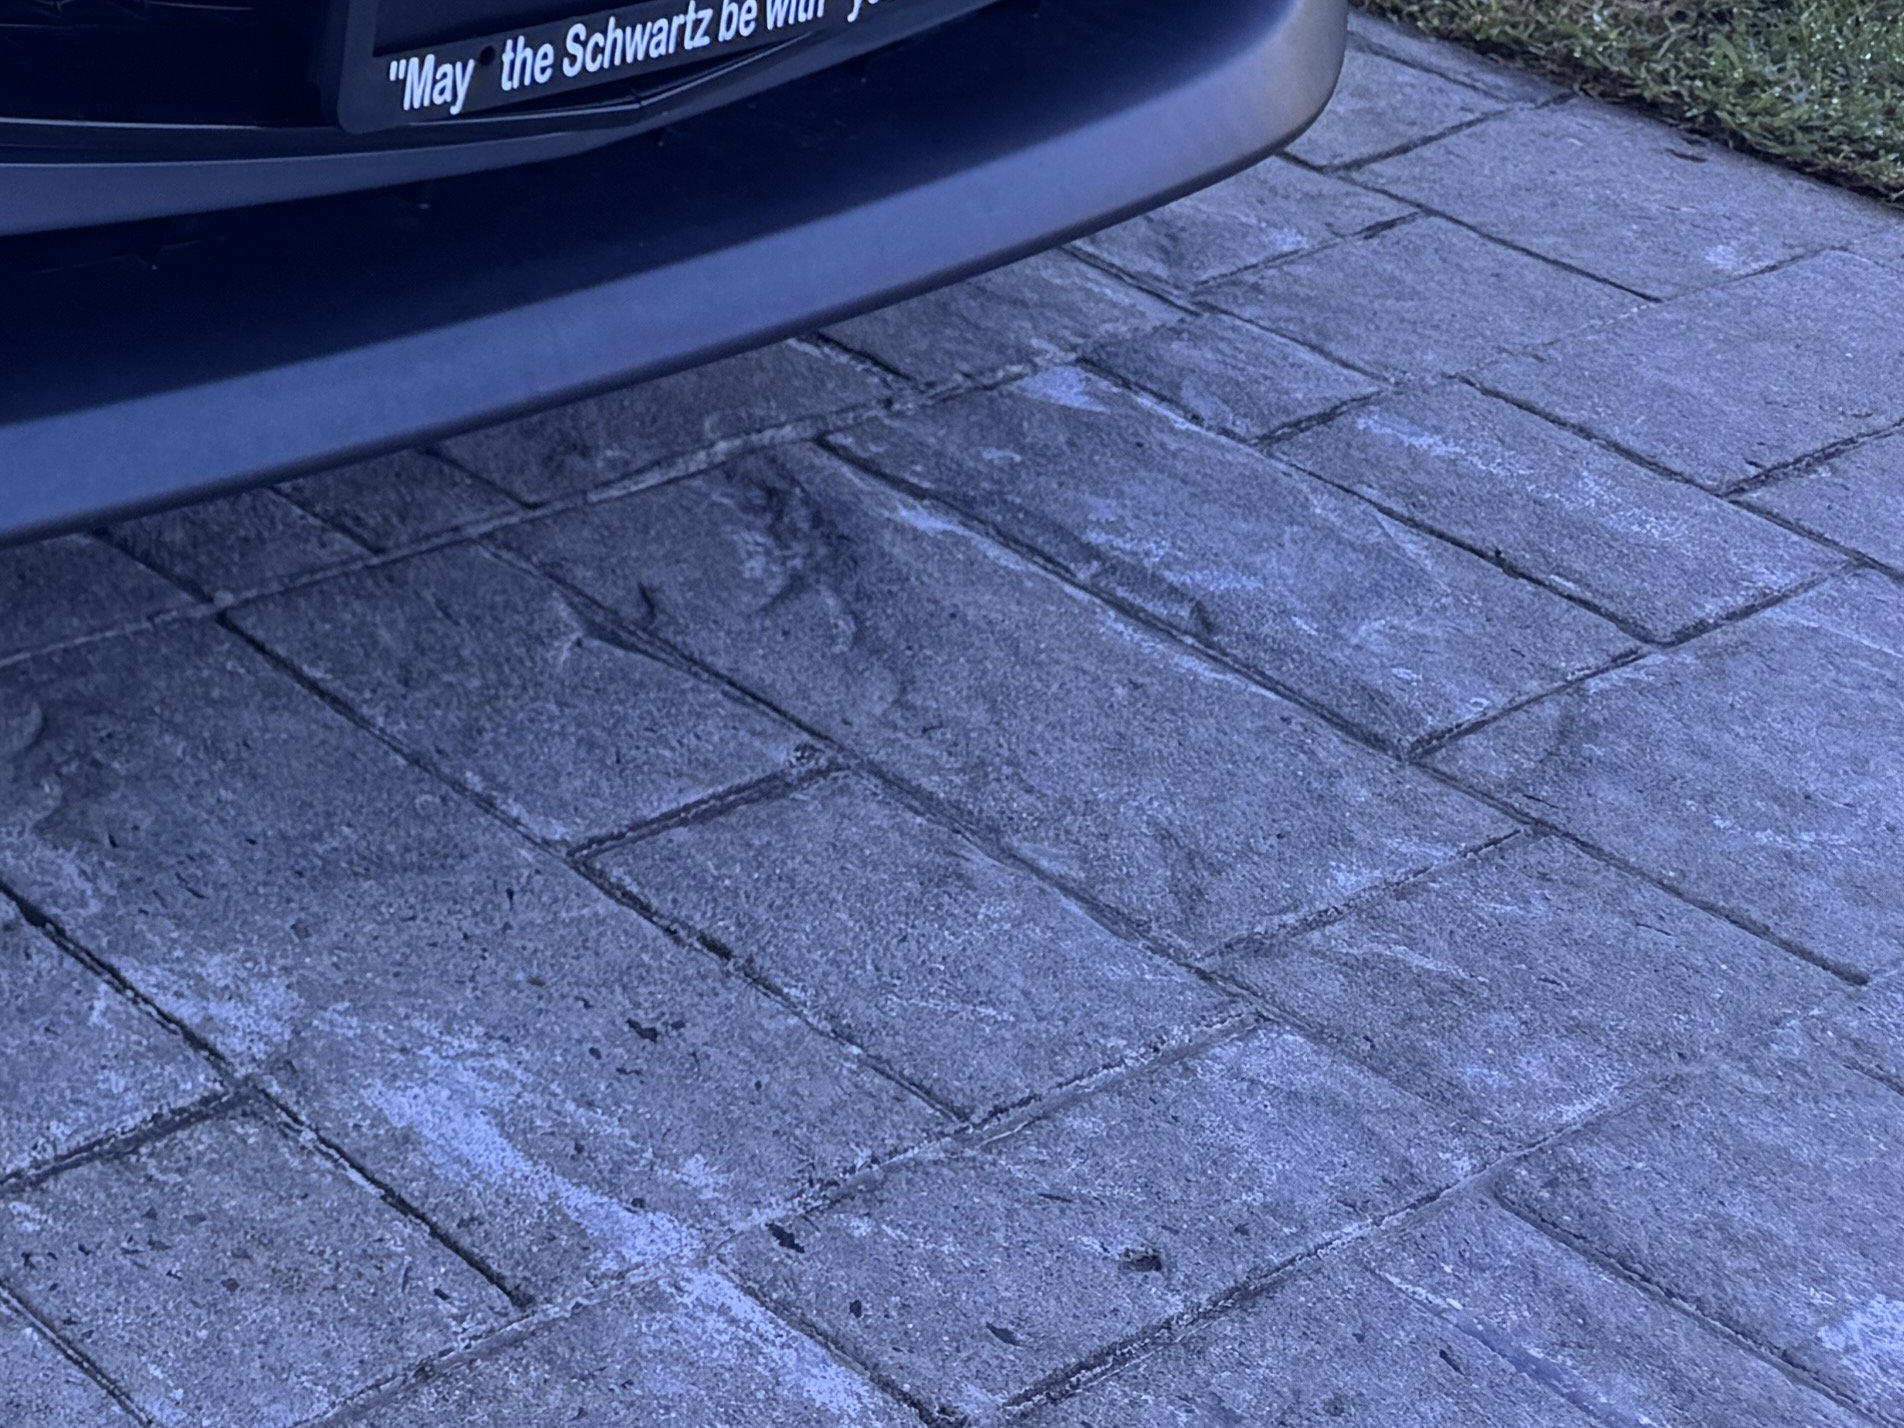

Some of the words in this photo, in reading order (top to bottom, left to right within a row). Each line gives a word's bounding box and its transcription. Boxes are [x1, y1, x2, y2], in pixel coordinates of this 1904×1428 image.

[389, 54, 476, 116] "May
[501, 35, 555, 92] the
[562, 0, 714, 78] Schwartz
